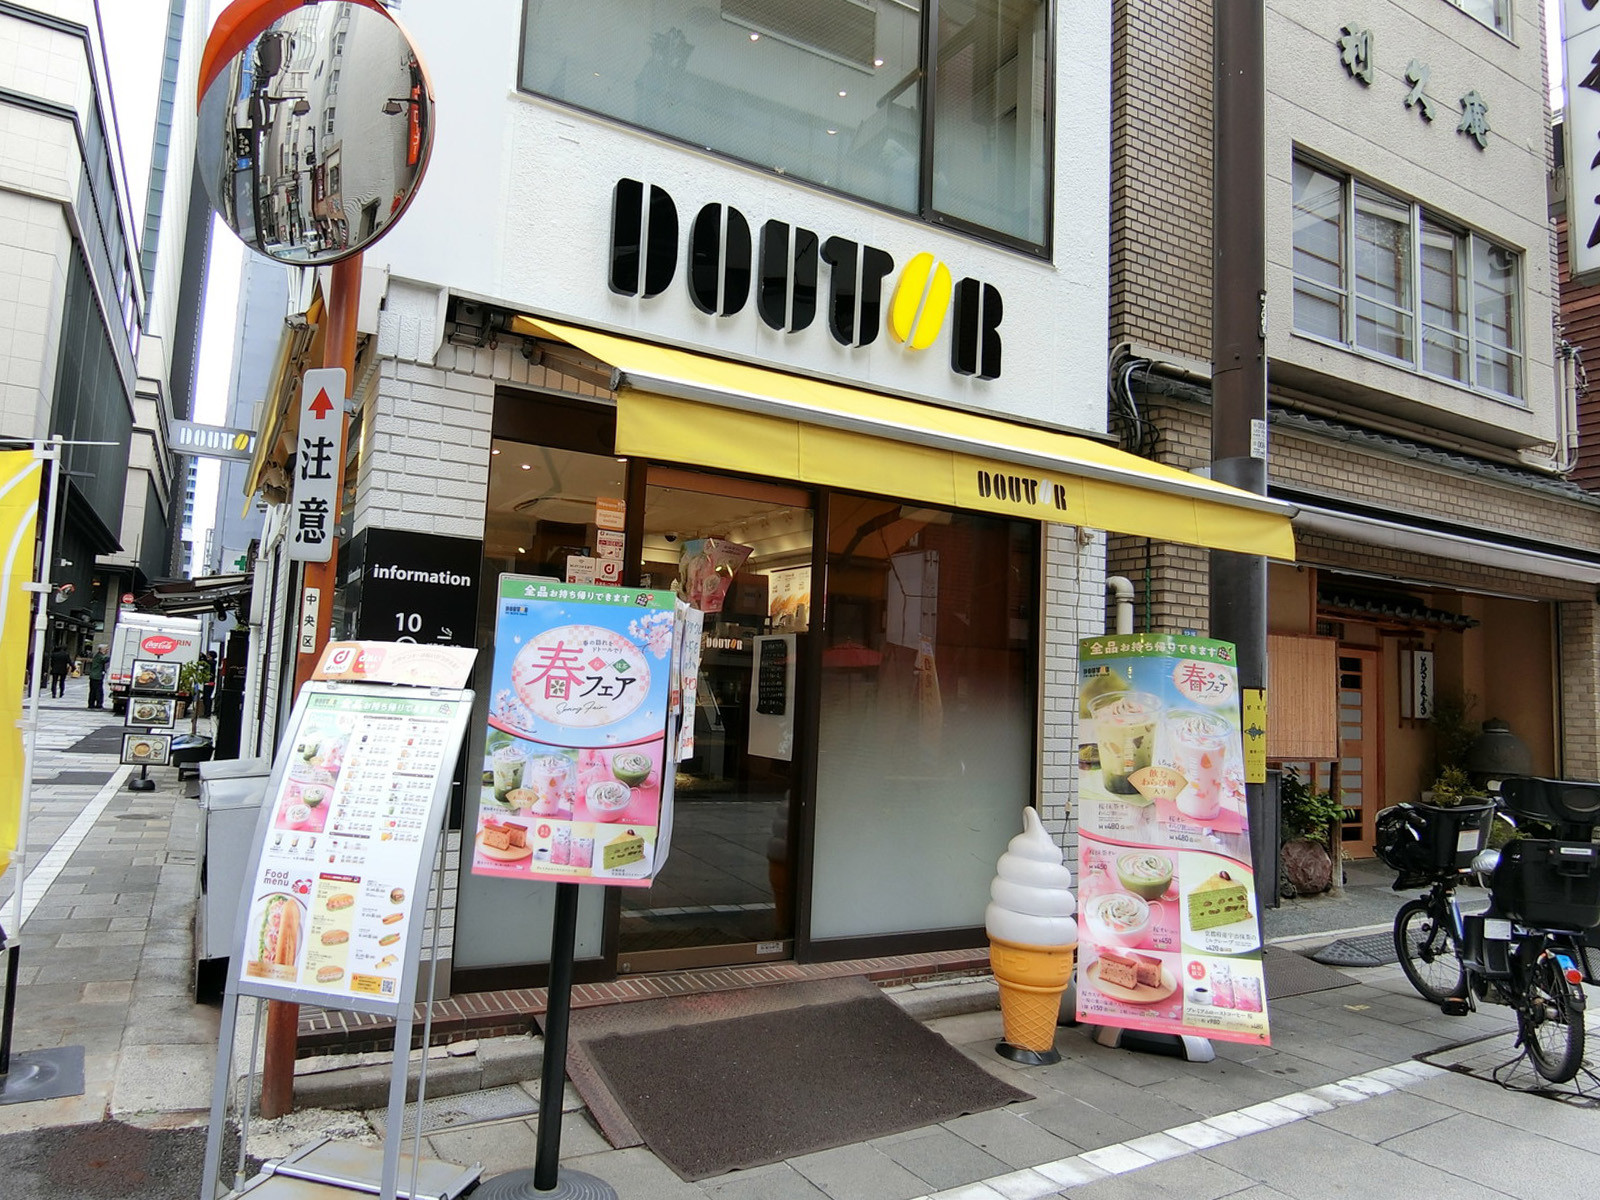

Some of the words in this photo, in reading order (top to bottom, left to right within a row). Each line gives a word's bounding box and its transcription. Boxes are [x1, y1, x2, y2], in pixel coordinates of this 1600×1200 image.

[608, 177, 1003, 381] DOUTOR
[295, 436, 335, 545] 注意
[977, 470, 1067, 511] DOUTOR
[373, 564, 471, 587] information
[524, 584, 630, 604] 全品お持ち帰りできます
[302, 592, 318, 649] 中央区
[395, 612, 422, 633] 10
[706, 637, 743, 650] DOUTOR
[1090, 640, 1217, 659] 全品お持ち帰りできます
[1181, 663, 1228, 693] 春フェア
[263, 877, 290, 887] menu
[265, 869, 289, 879] Food
